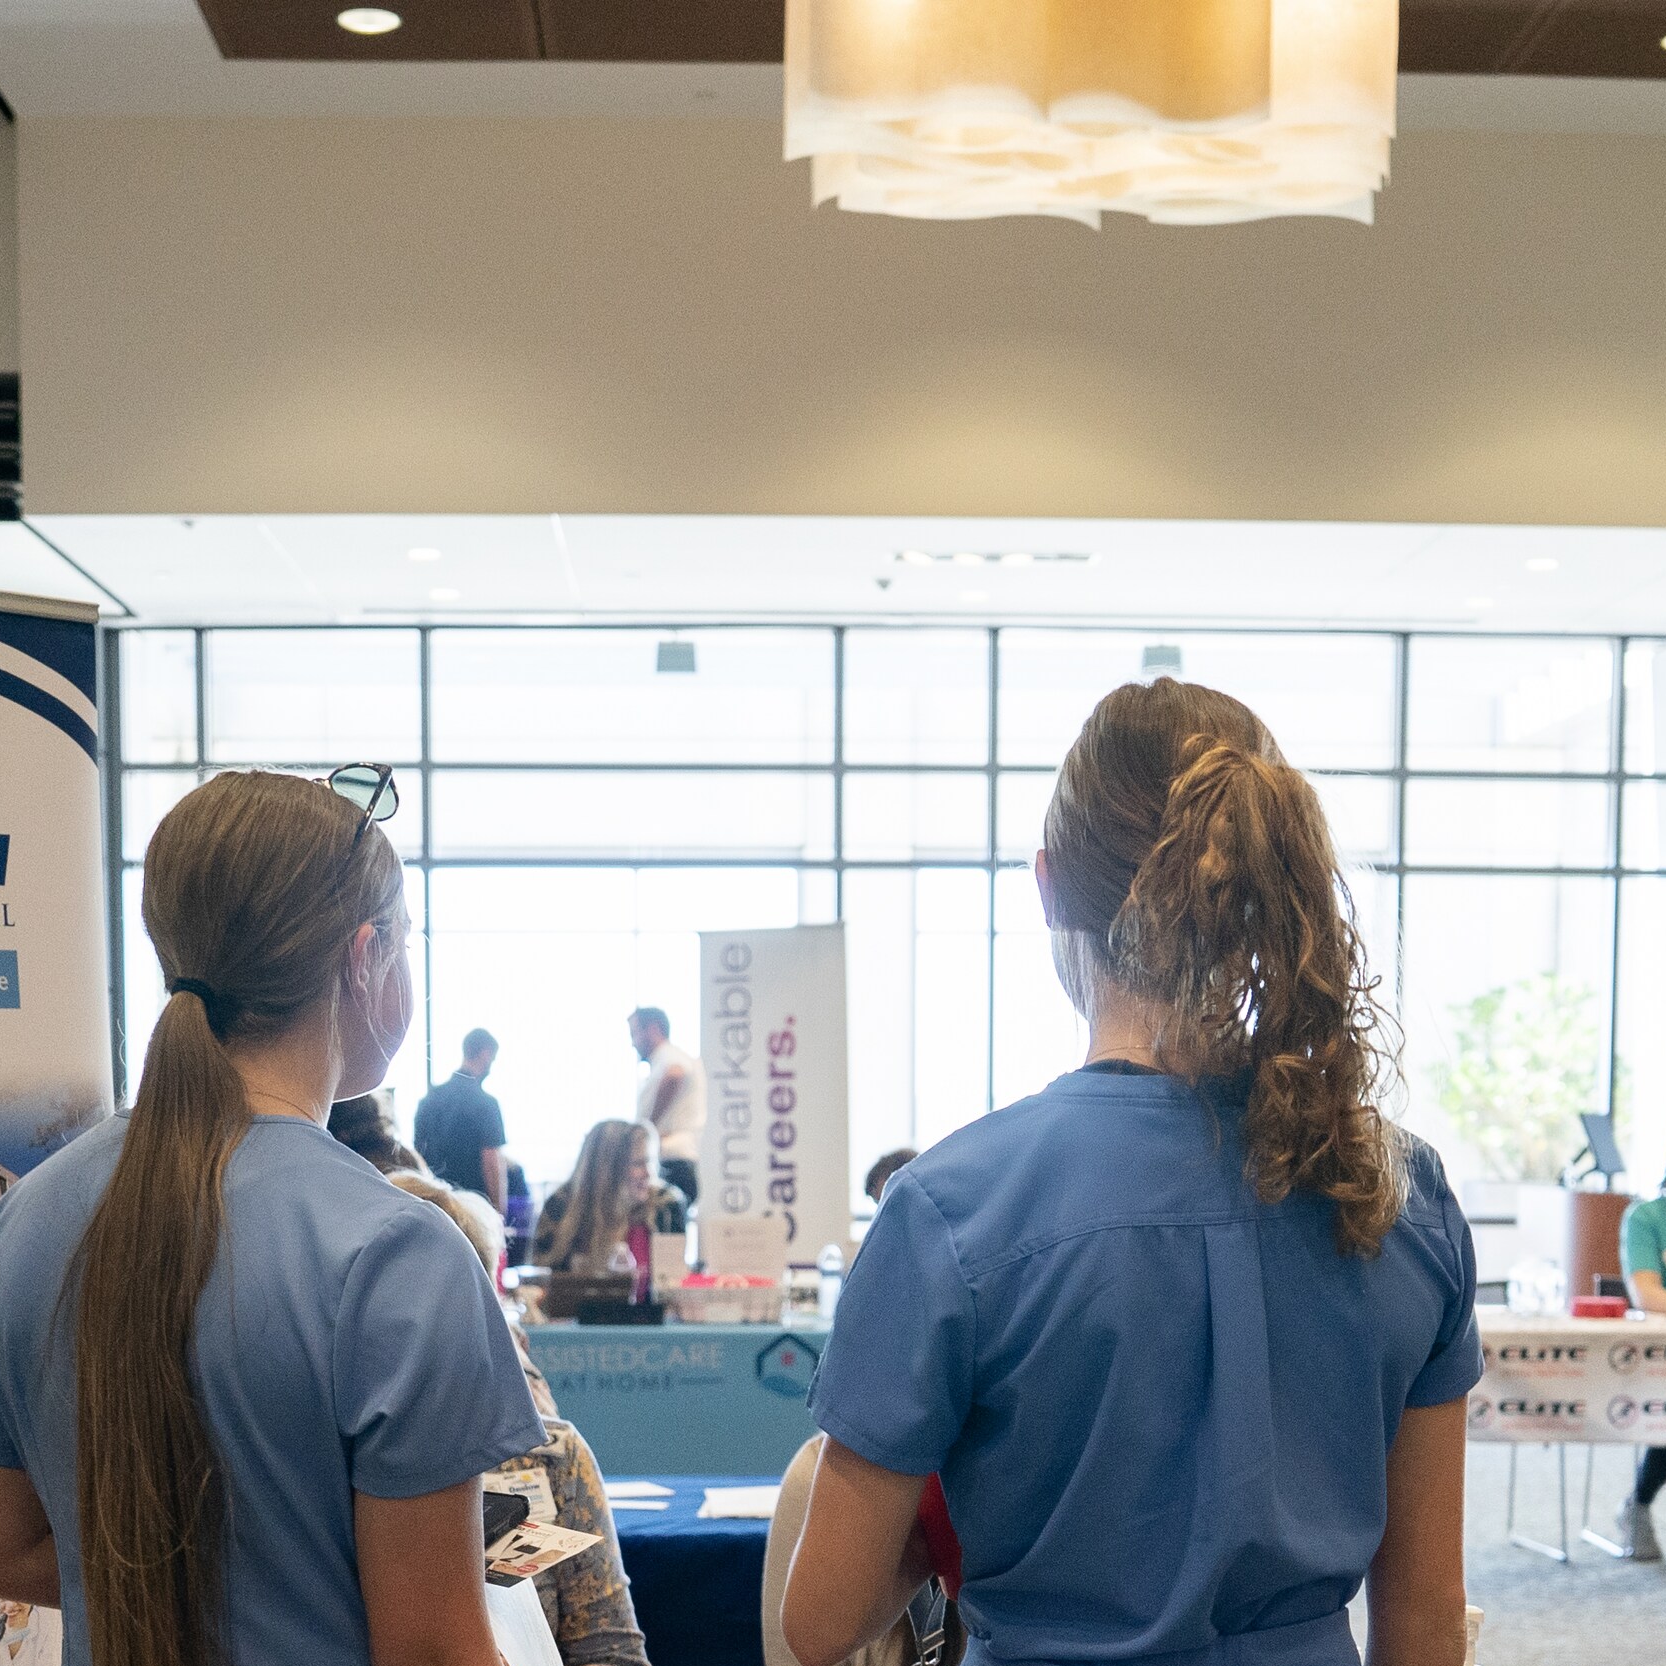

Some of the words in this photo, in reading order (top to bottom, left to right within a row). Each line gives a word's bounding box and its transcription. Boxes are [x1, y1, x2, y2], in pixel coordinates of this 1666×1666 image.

[713, 940, 754, 1215] emarkable
[1498, 1344, 1586, 1361] ELITE
[1497, 1399, 1585, 1415] ELITE
